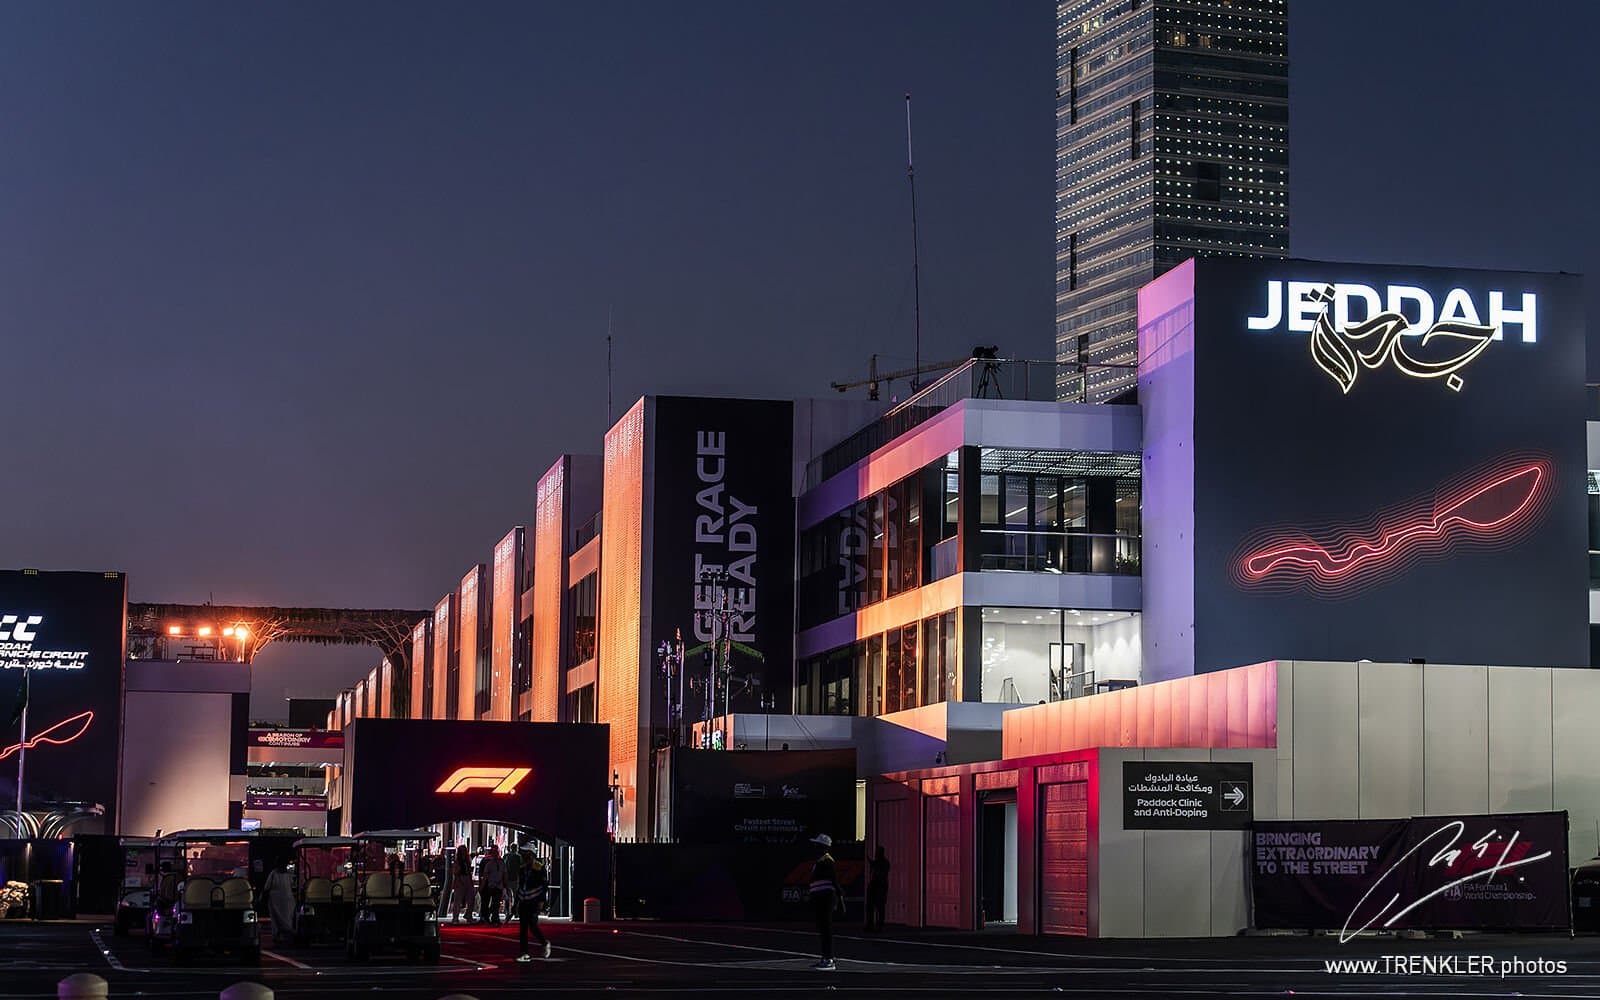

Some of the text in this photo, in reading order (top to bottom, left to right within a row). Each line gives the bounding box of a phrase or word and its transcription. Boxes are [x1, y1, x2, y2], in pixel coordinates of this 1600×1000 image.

[1247, 280, 1537, 343] JEDDAH
[694, 431, 725, 642] GET RACE
[727, 496, 757, 642] READY
[41, 651, 88, 659] CIRCUIT
[435, 767, 533, 794] F1
[1144, 773, 1174, 784] البادوك
[1128, 783, 1213, 794] ومكافحة المنشطات
[1137, 798, 1203, 807] Paddock Clinic
[1133, 808, 1208, 818] and Anti-Doping
[1256, 832, 1321, 846] BRINGING
[1256, 846, 1380, 860] EXTRAORDINARY
[1257, 861, 1368, 874] TO THE STREET
